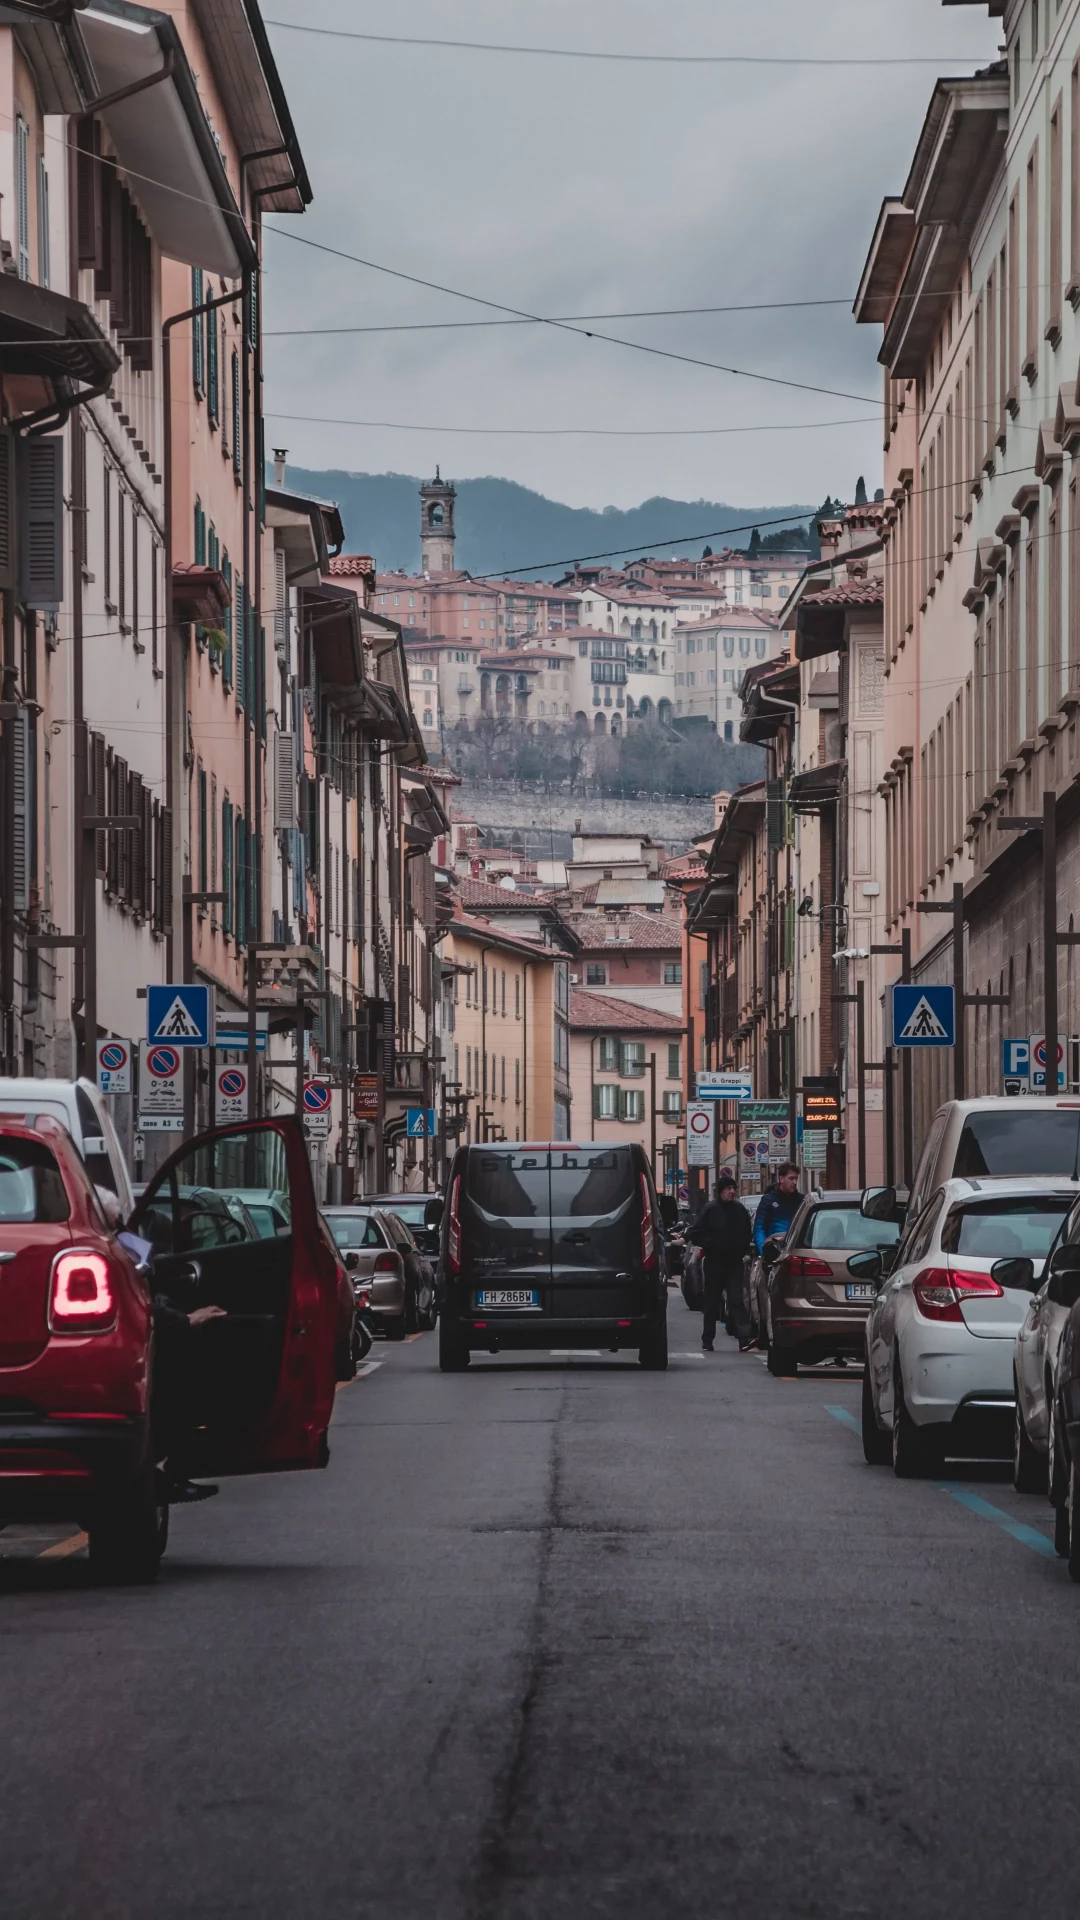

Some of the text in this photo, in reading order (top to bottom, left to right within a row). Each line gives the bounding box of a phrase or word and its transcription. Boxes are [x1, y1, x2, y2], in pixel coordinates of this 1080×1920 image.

[1010, 1043, 1028, 1072] P
[364, 1097, 378, 1106] Gall
[484, 1291, 532, 1302] FH 286BW
